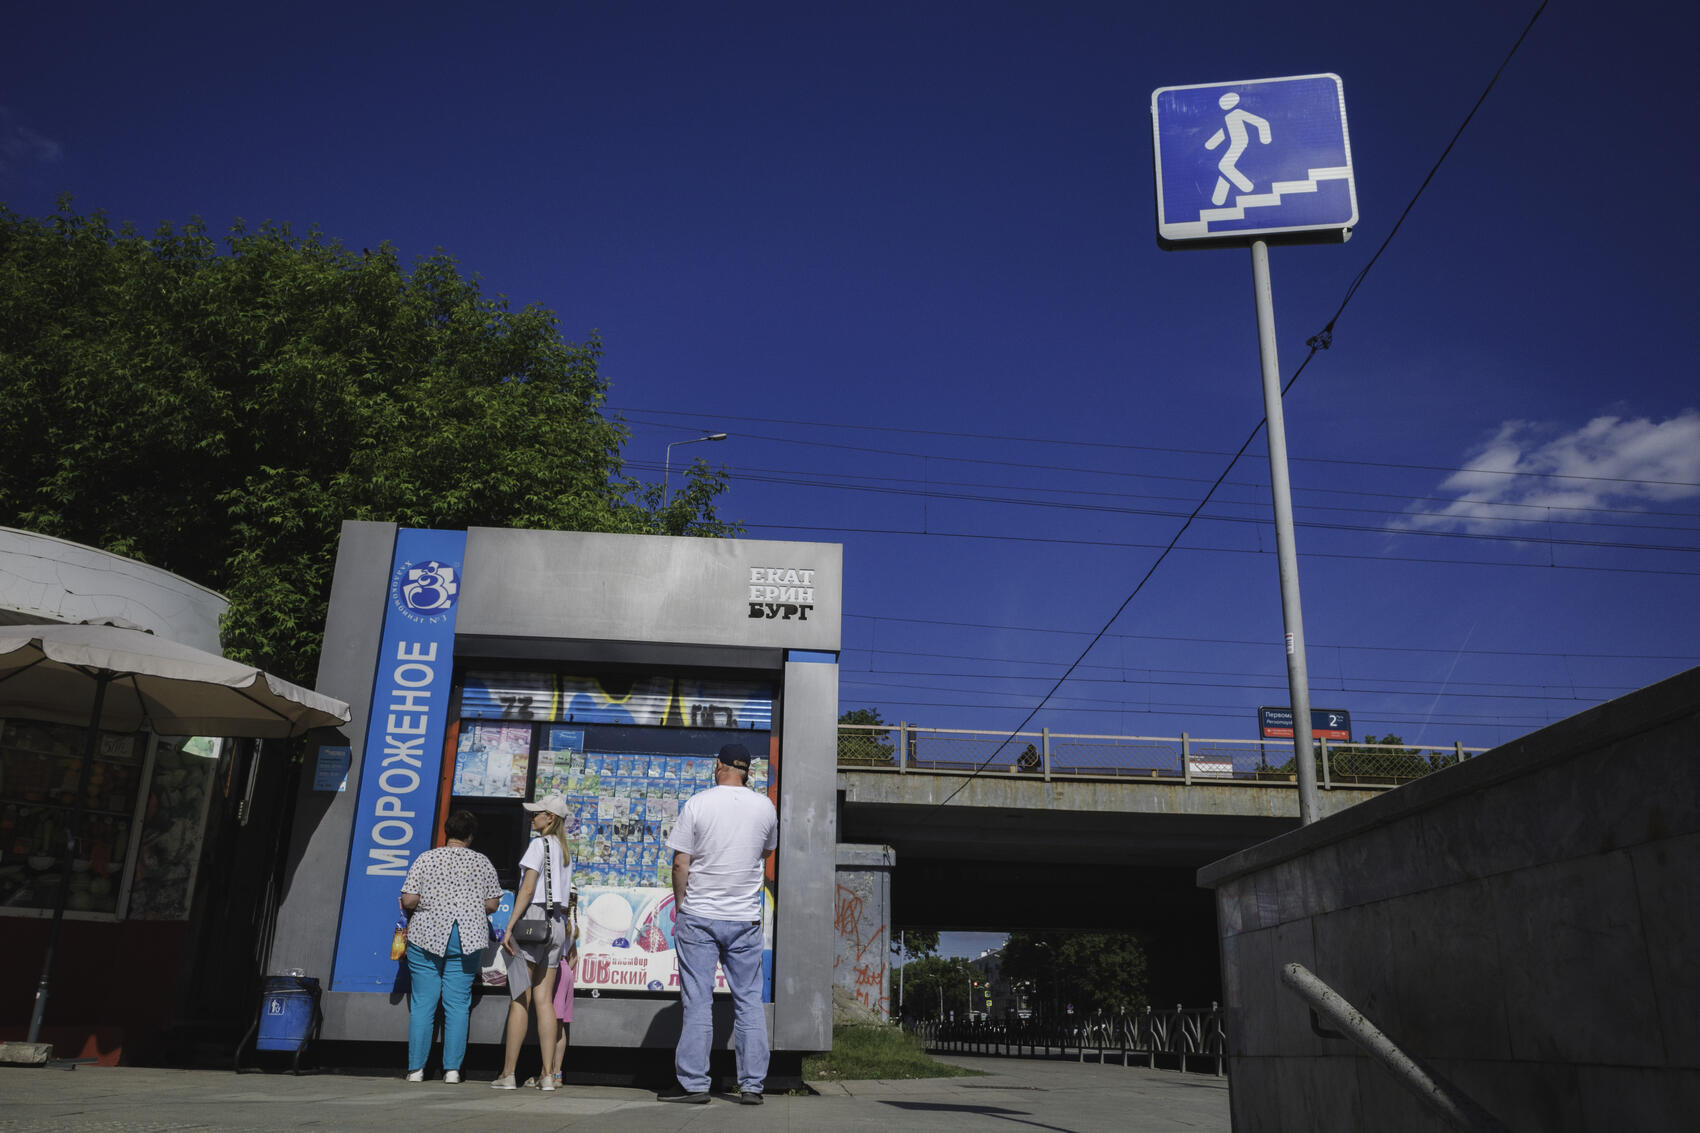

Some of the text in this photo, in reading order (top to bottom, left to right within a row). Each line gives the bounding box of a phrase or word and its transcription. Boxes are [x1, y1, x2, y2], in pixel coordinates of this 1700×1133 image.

[750, 566, 815, 585] ЕКАТ
[749, 584, 815, 603] ЕРИН
[748, 602, 814, 621] БУРГ
[1328, 714, 1338, 727] 2
[366, 641, 438, 877] МОРОЖЕНОЕ
